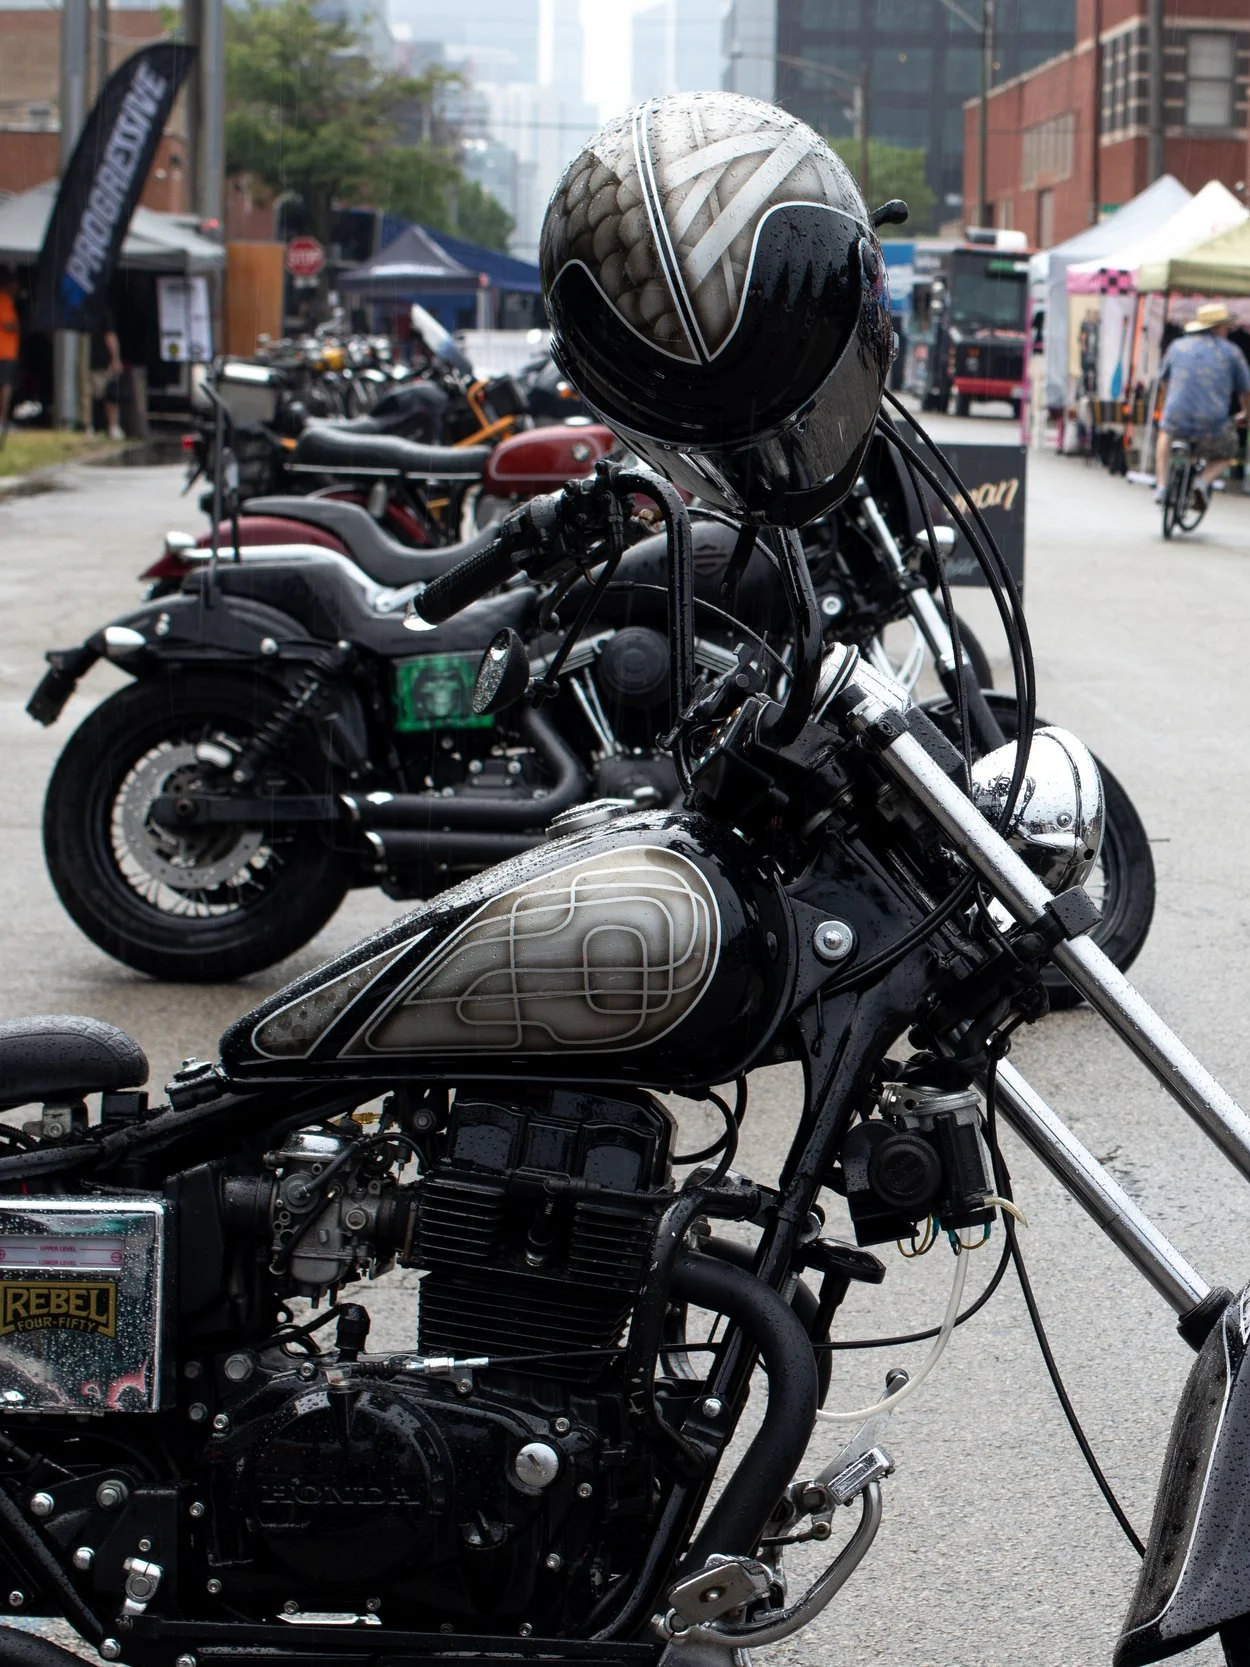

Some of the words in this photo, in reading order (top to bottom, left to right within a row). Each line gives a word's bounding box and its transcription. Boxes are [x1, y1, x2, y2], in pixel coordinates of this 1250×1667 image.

[67, 60, 167, 294] PROGRESSIVE
[288, 250, 321, 265] STOP
[6, 1288, 108, 1324] REBEL
[16, 1317, 96, 1332] FOUR-FIFTY
[261, 1485, 421, 1505] HONDA
